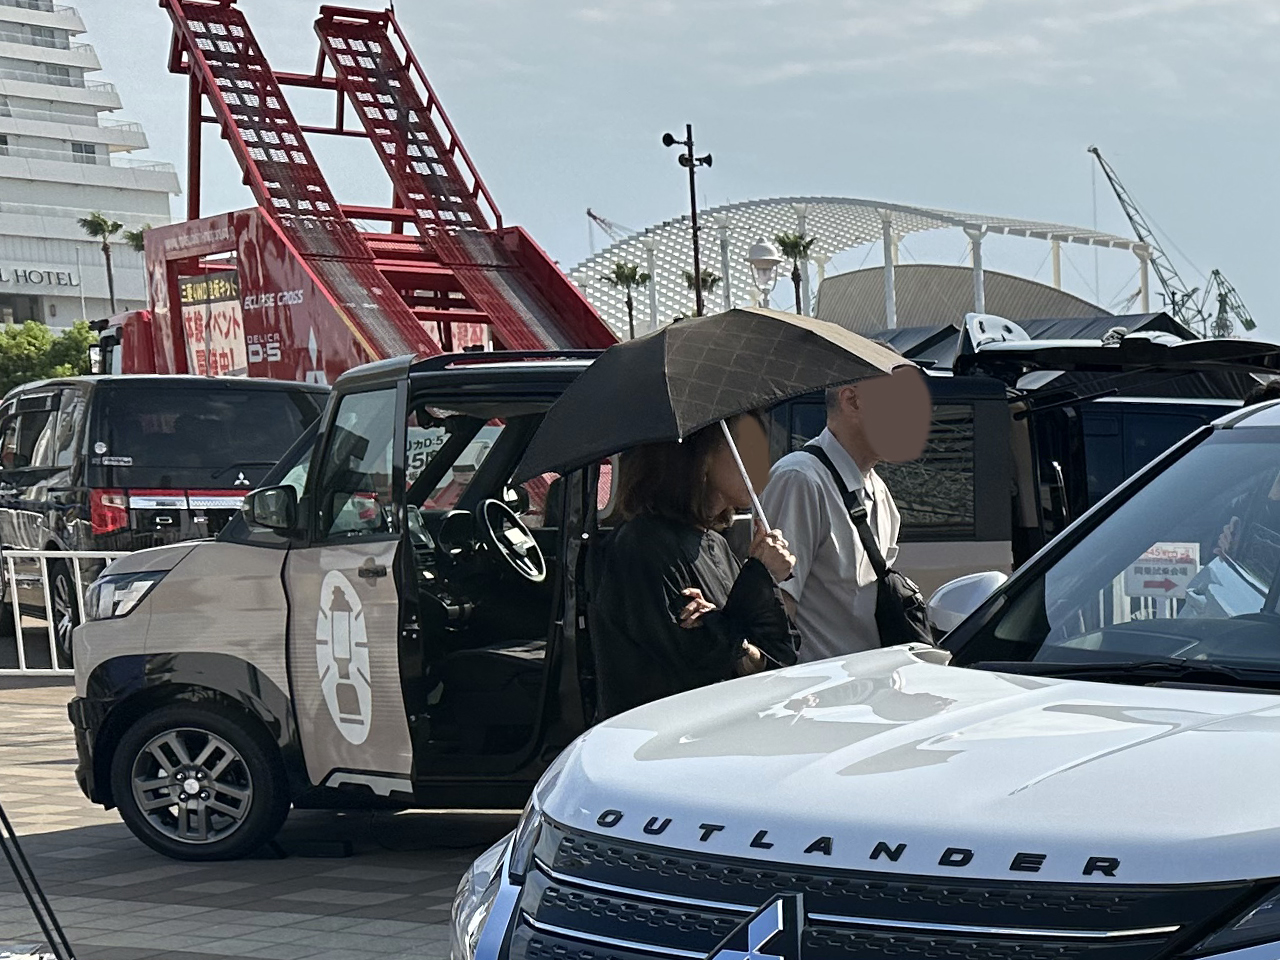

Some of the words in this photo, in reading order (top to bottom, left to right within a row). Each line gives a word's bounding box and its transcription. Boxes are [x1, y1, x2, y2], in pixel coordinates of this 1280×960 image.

[14, 268, 80, 287] HOTEL
[244, 293, 275, 310] ECLIPSE
[277, 289, 304, 306] CROSS
[247, 333, 280, 344] DELICA
[248, 342, 282, 363] D:5
[595, 808, 1122, 878] OUTLANDER
